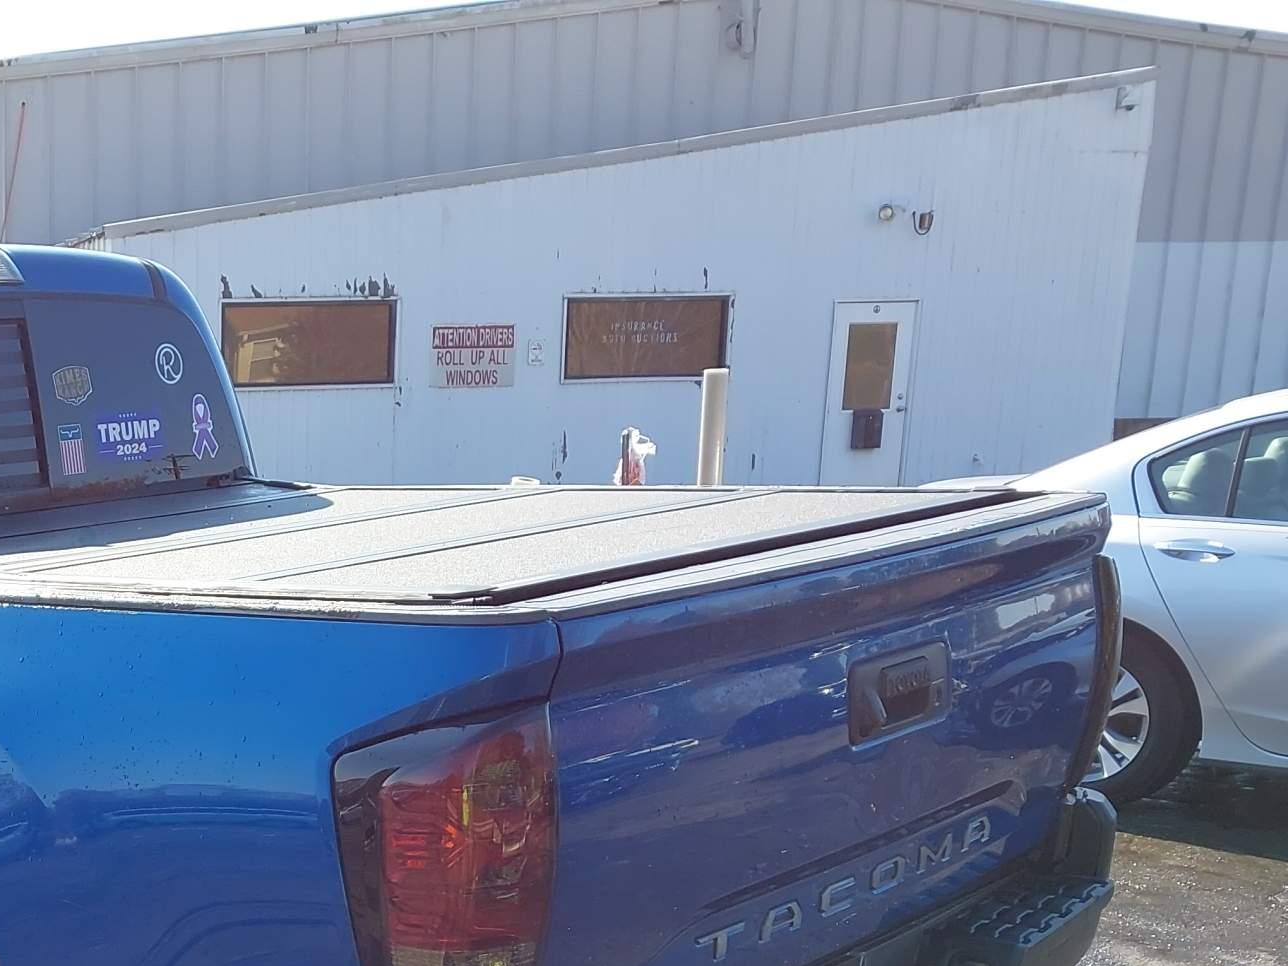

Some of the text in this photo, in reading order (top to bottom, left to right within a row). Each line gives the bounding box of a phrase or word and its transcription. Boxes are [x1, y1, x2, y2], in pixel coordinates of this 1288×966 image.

[433, 327, 513, 347] ATTENTION DRIVERS
[437, 349, 509, 366] ROLL UP ALL
[445, 369, 498, 386] WINDOWS
[97, 419, 160, 443] TRUMP
[116, 442, 147, 455] 2024
[694, 815, 992, 962] TACOMA
